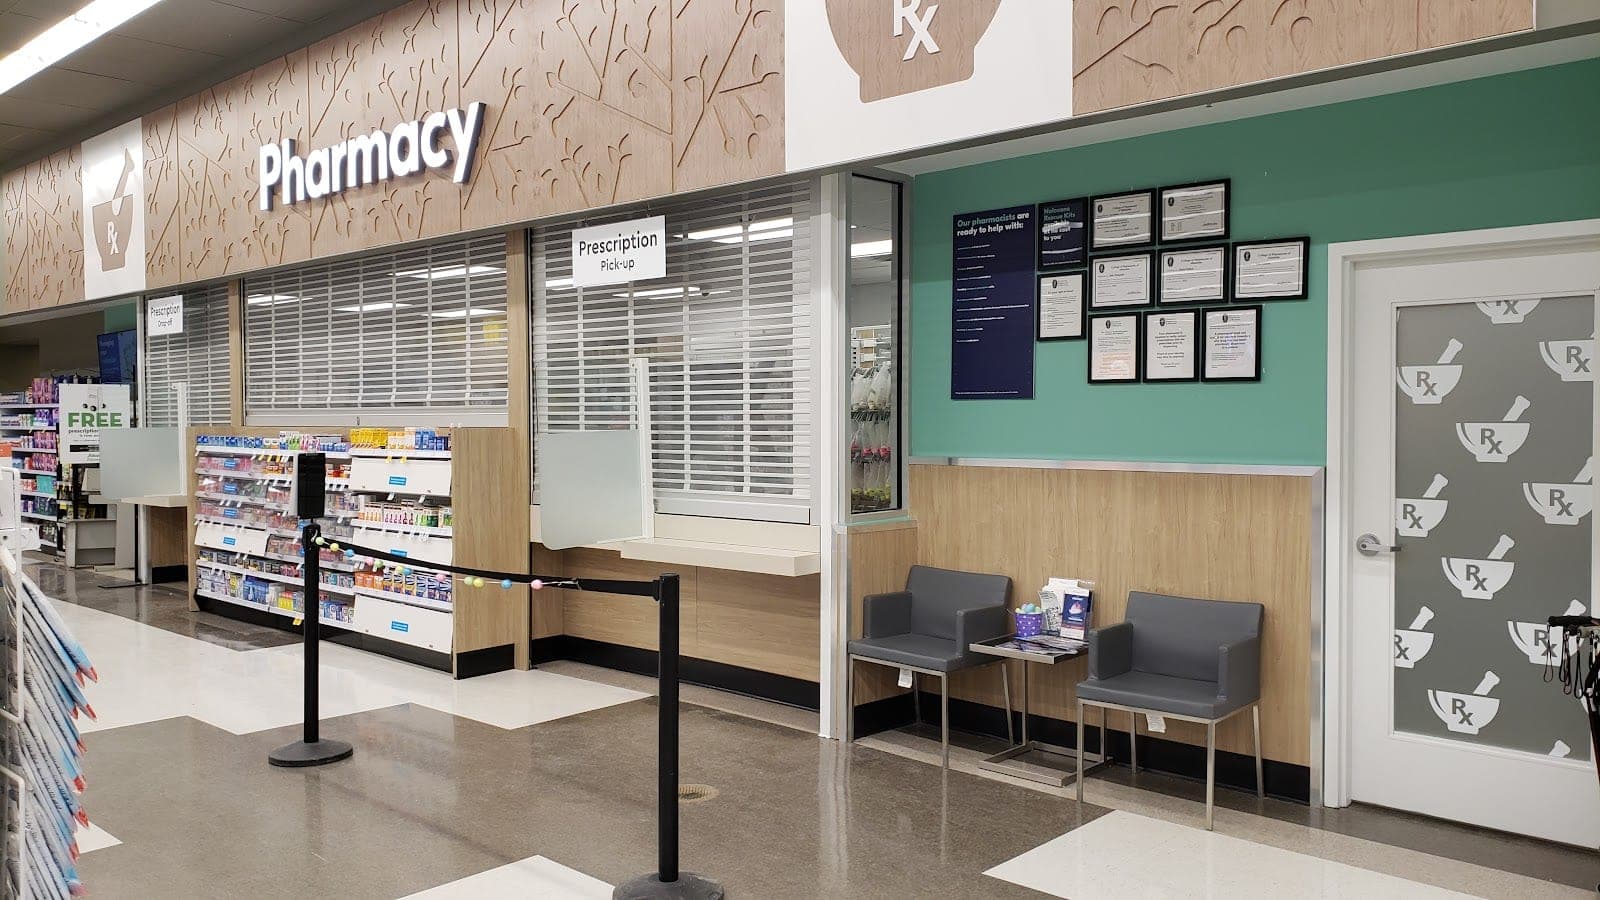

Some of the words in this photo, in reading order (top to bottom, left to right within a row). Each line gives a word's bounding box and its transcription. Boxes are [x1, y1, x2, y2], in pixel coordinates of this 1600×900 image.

[259, 101, 487, 211] Pharmacy
[957, 219, 970, 228] Our
[972, 213, 1016, 226] pharmacists
[1016, 212, 1030, 220] are
[957, 226, 978, 237] ready
[979, 224, 987, 234] to
[987, 223, 1004, 234] help
[1005, 220, 1024, 230] with:
[107, 221, 120, 256] Rx
[578, 230, 658, 257] Prescription
[600, 258, 635, 272] Pick-up
[150, 303, 181, 318] Prescription
[1565, 345, 1591, 373] Rx
[1416, 370, 1437, 397] Rx
[68, 412, 123, 428] FREE
[1480, 428, 1503, 455] Rx
[1548, 488, 1574, 517] Rx
[1402, 503, 1424, 530] Rx
[1465, 563, 1488, 592] Rx
[1534, 628, 1558, 658] Rx
[1451, 697, 1474, 727] Rx
